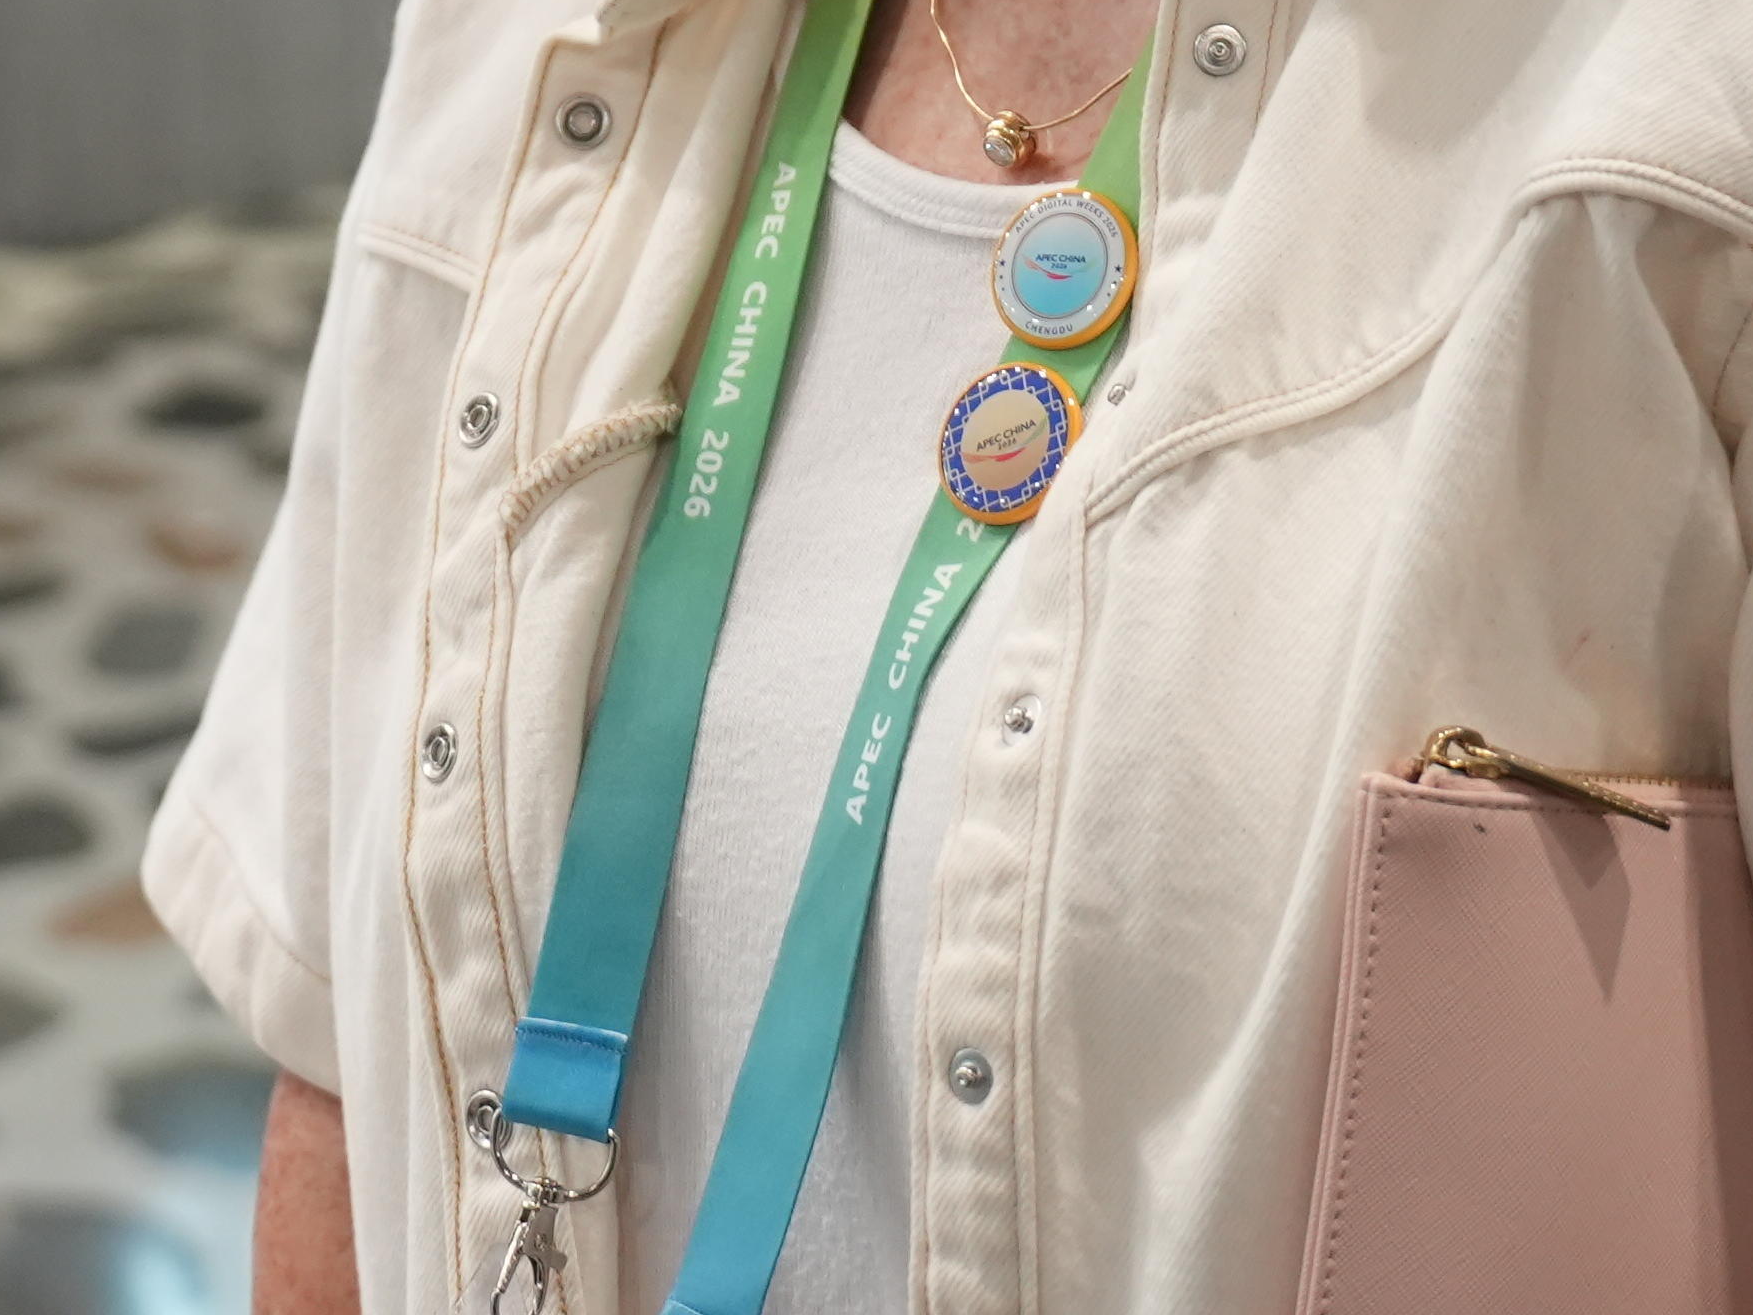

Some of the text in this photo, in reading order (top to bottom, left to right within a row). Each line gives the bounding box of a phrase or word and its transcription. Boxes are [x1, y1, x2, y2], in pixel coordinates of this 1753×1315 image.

[1015, 199, 1118, 238] APEC DIGITAL WEEKS 2026
[1035, 253, 1086, 263] APEC CHINA
[683, 160, 796, 519] APEC CHINA 2026
[1024, 321, 1073, 336] CHENGDU
[976, 419, 1036, 452] APEC CHINA
[845, 712, 892, 826] APEC
[888, 562, 963, 690] CHINA
